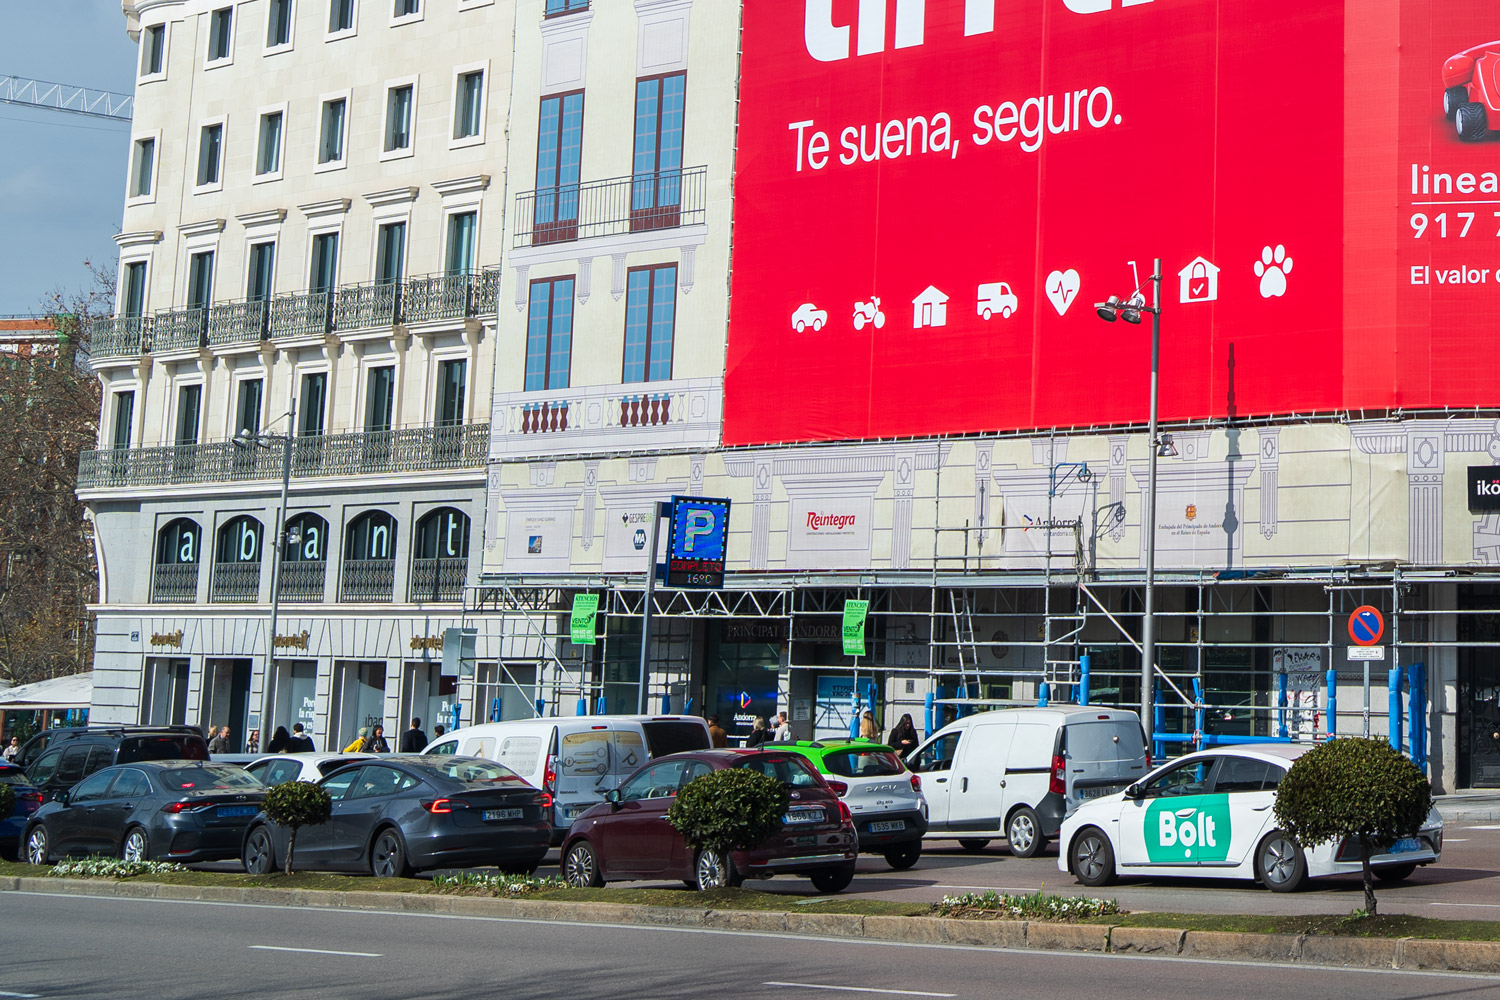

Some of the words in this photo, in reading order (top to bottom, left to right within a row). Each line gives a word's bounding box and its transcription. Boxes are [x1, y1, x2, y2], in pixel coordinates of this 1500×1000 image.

[788, 119, 830, 172] Te
[839, 111, 960, 166] suena,
[972, 85, 1123, 153] seguro.
[1411, 163, 1498, 195] linea
[1410, 212, 1475, 239] 917
[1410, 265, 1430, 285] El
[1435, 265, 1490, 285] valor
[684, 508, 715, 552] P
[806, 511, 856, 530] Reintegra
[670, 561, 723, 573] COMPLETO
[783, 625, 843, 637] DANDORR
[1159, 809, 1217, 847] Bolt
